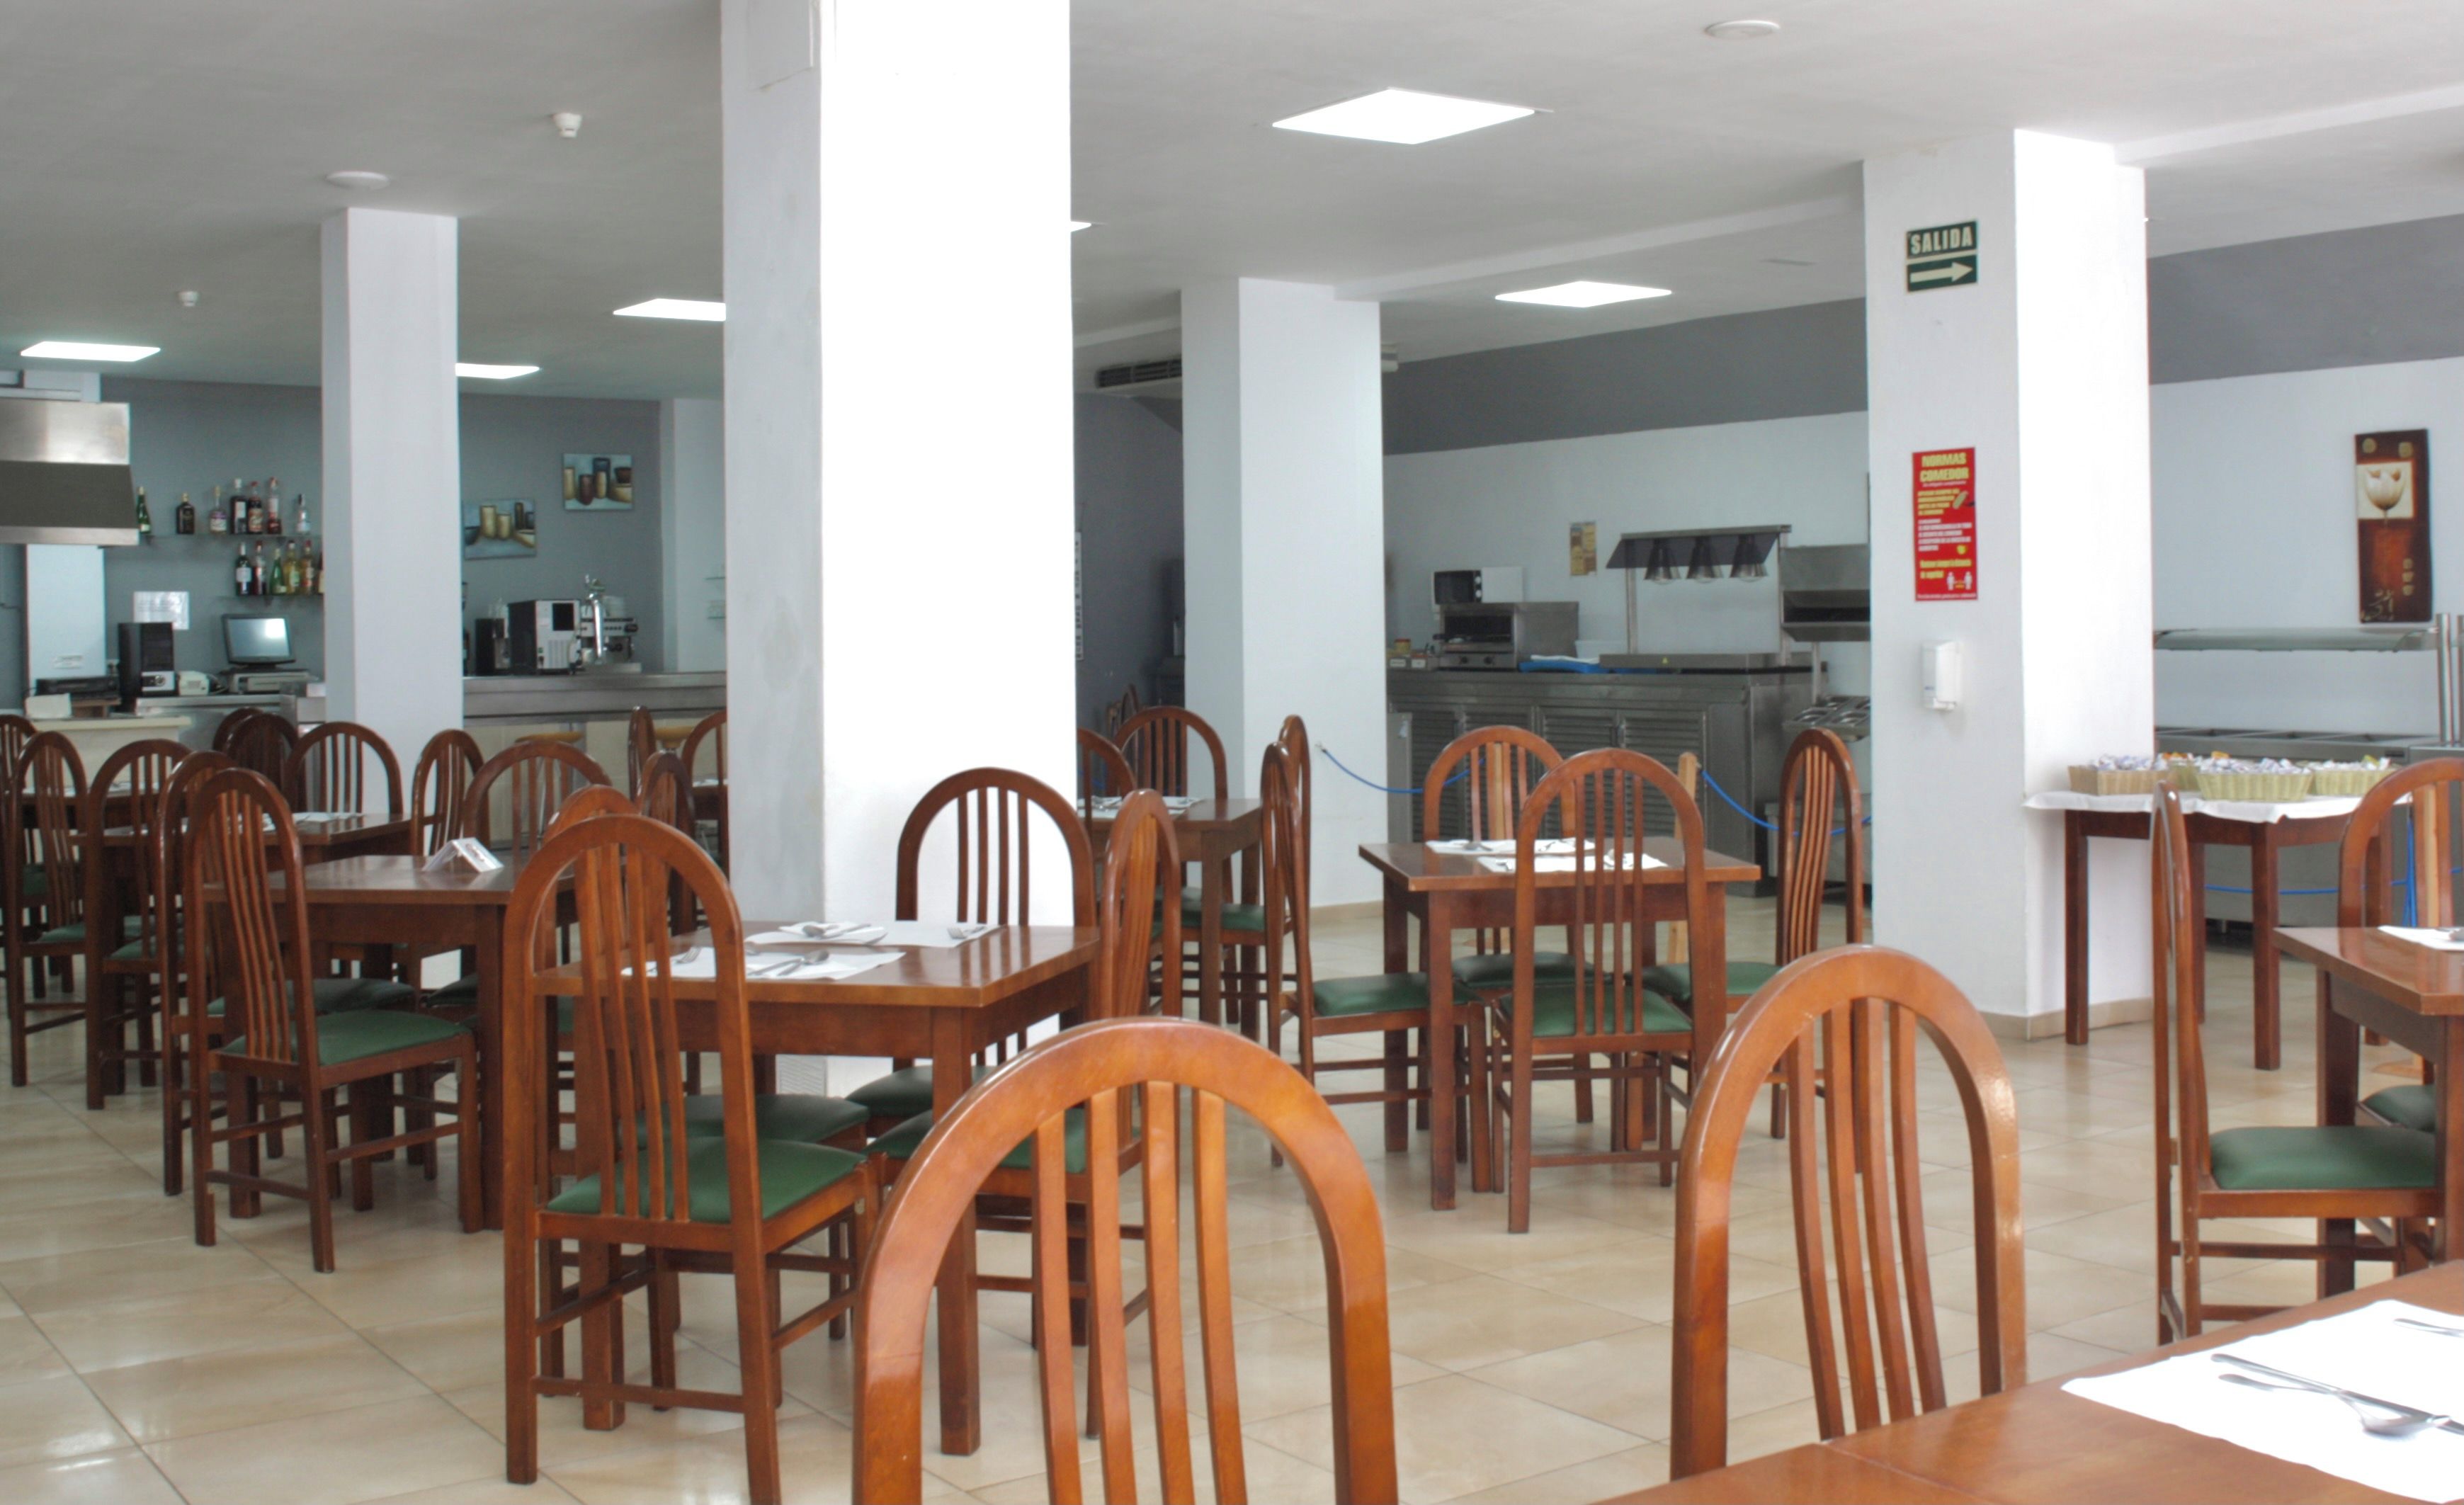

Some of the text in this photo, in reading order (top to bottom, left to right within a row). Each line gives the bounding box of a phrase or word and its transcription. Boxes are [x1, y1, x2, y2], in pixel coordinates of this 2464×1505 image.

[1911, 226, 1972, 254] SALIDA
[1921, 453, 1966, 467] NORMAS
[1920, 467, 1969, 483] COMEDOR
